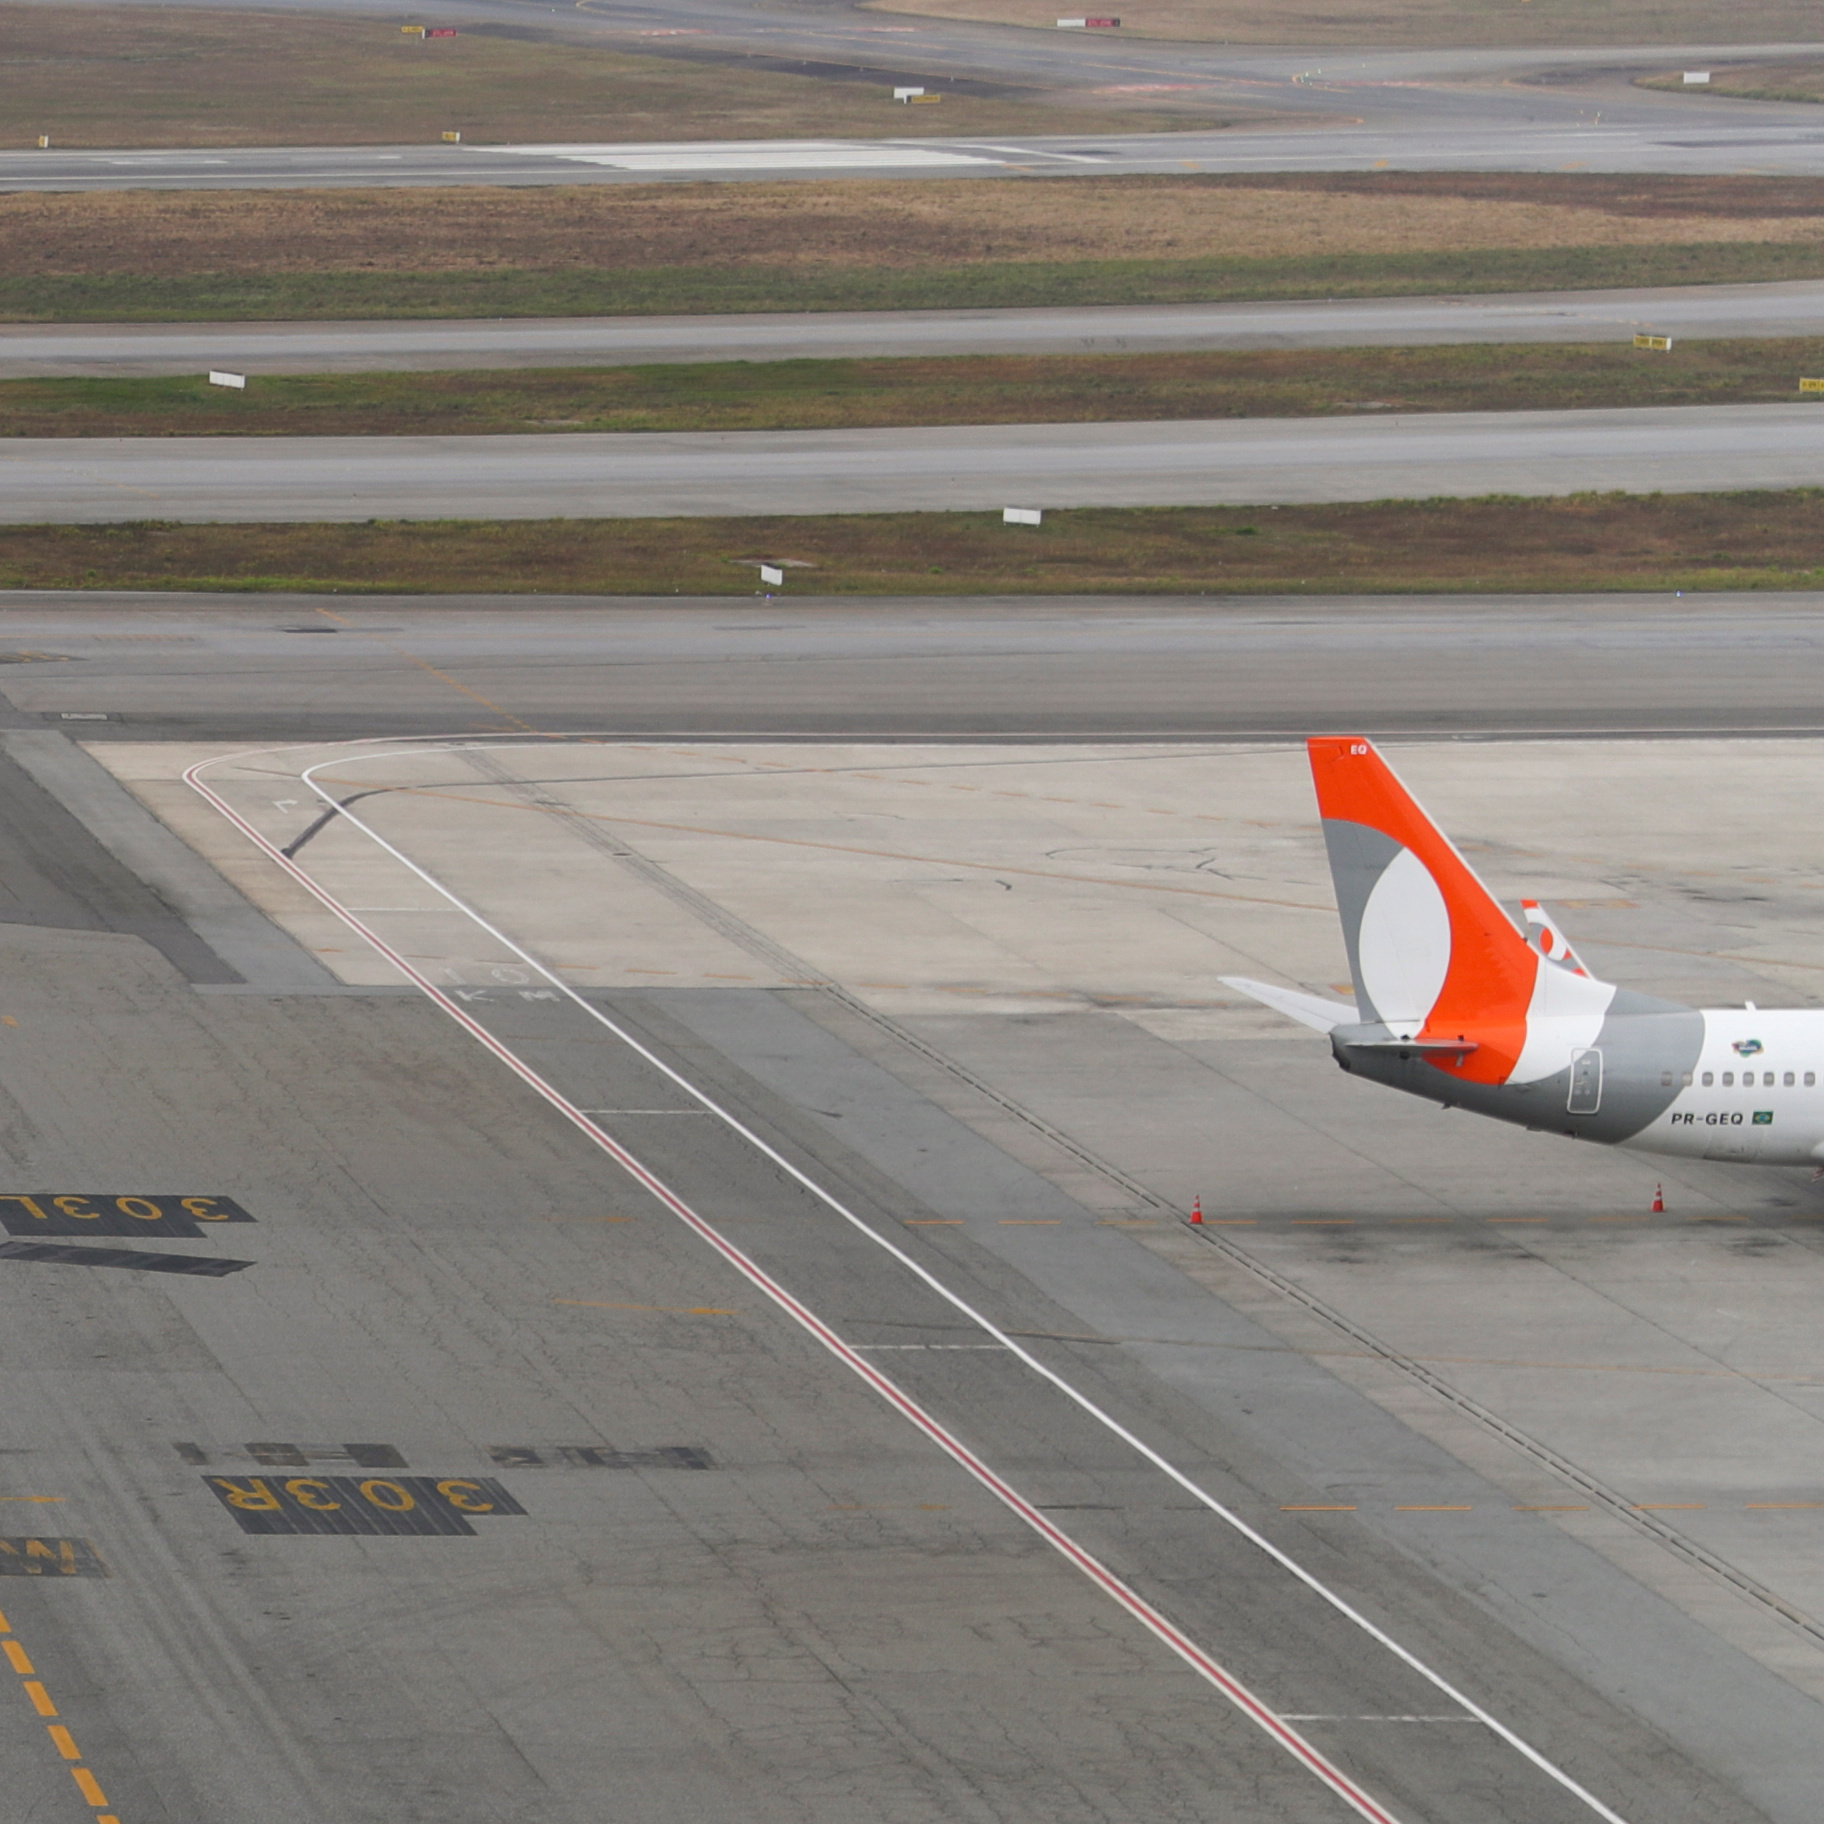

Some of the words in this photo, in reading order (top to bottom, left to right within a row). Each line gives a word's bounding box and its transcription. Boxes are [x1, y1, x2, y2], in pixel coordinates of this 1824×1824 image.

[1350, 744, 1367, 755] EQ
[1671, 1112, 1744, 1125] PR-GEQ
[213, 1477, 495, 1513] 303R
